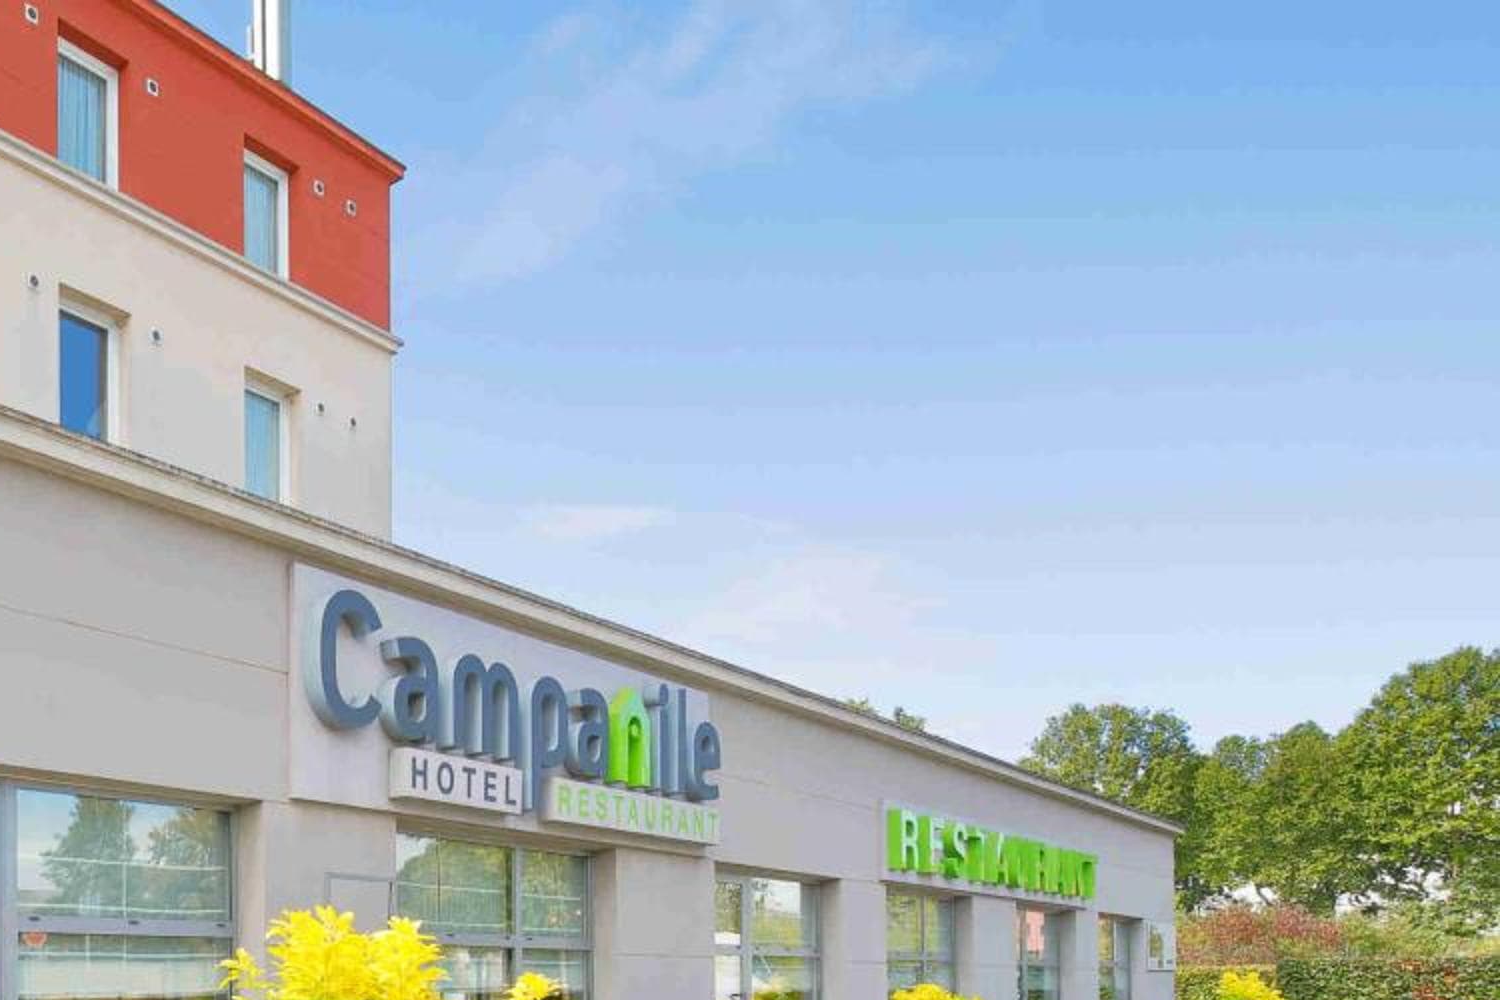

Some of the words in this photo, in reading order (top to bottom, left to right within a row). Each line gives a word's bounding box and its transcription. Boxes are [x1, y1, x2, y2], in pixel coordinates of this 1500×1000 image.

[308, 589, 722, 811] Campanile
[411, 755, 517, 806] HOTEL
[558, 783, 719, 840] RESTAURANT
[886, 807, 1098, 899] RESTAURANT
